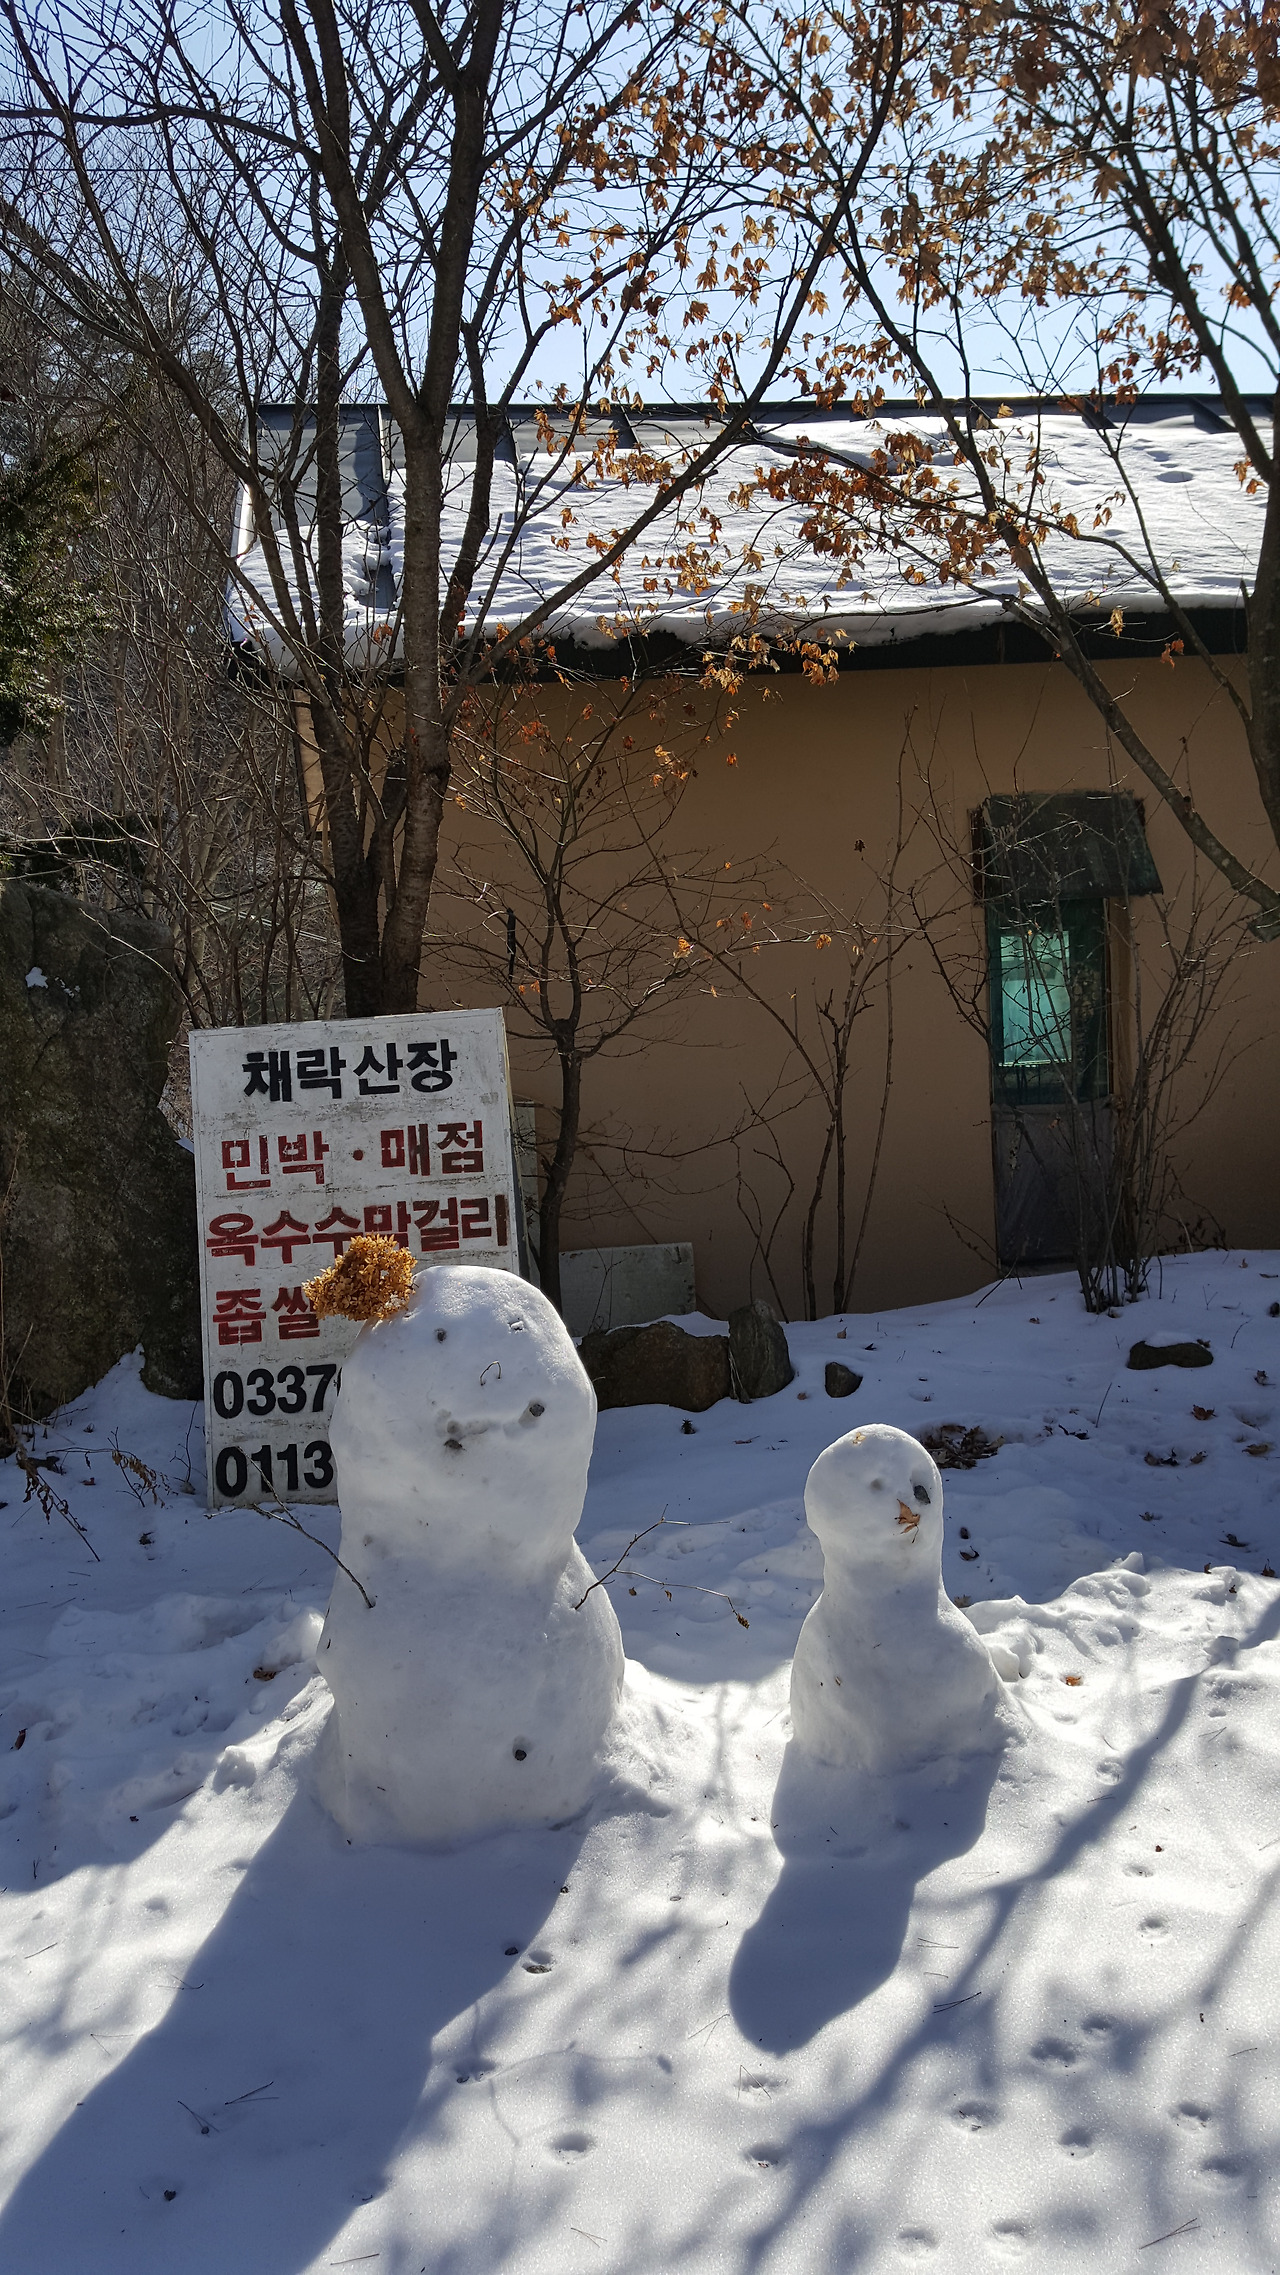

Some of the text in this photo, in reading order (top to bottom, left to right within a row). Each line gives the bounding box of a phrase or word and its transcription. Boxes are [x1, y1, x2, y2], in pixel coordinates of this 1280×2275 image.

[242, 1039, 458, 1102] 채락산장
[221, 1120, 485, 1191] 민박 매점
[212, 1363, 343, 1420] 0337
[215, 1440, 335, 1498] 0113
